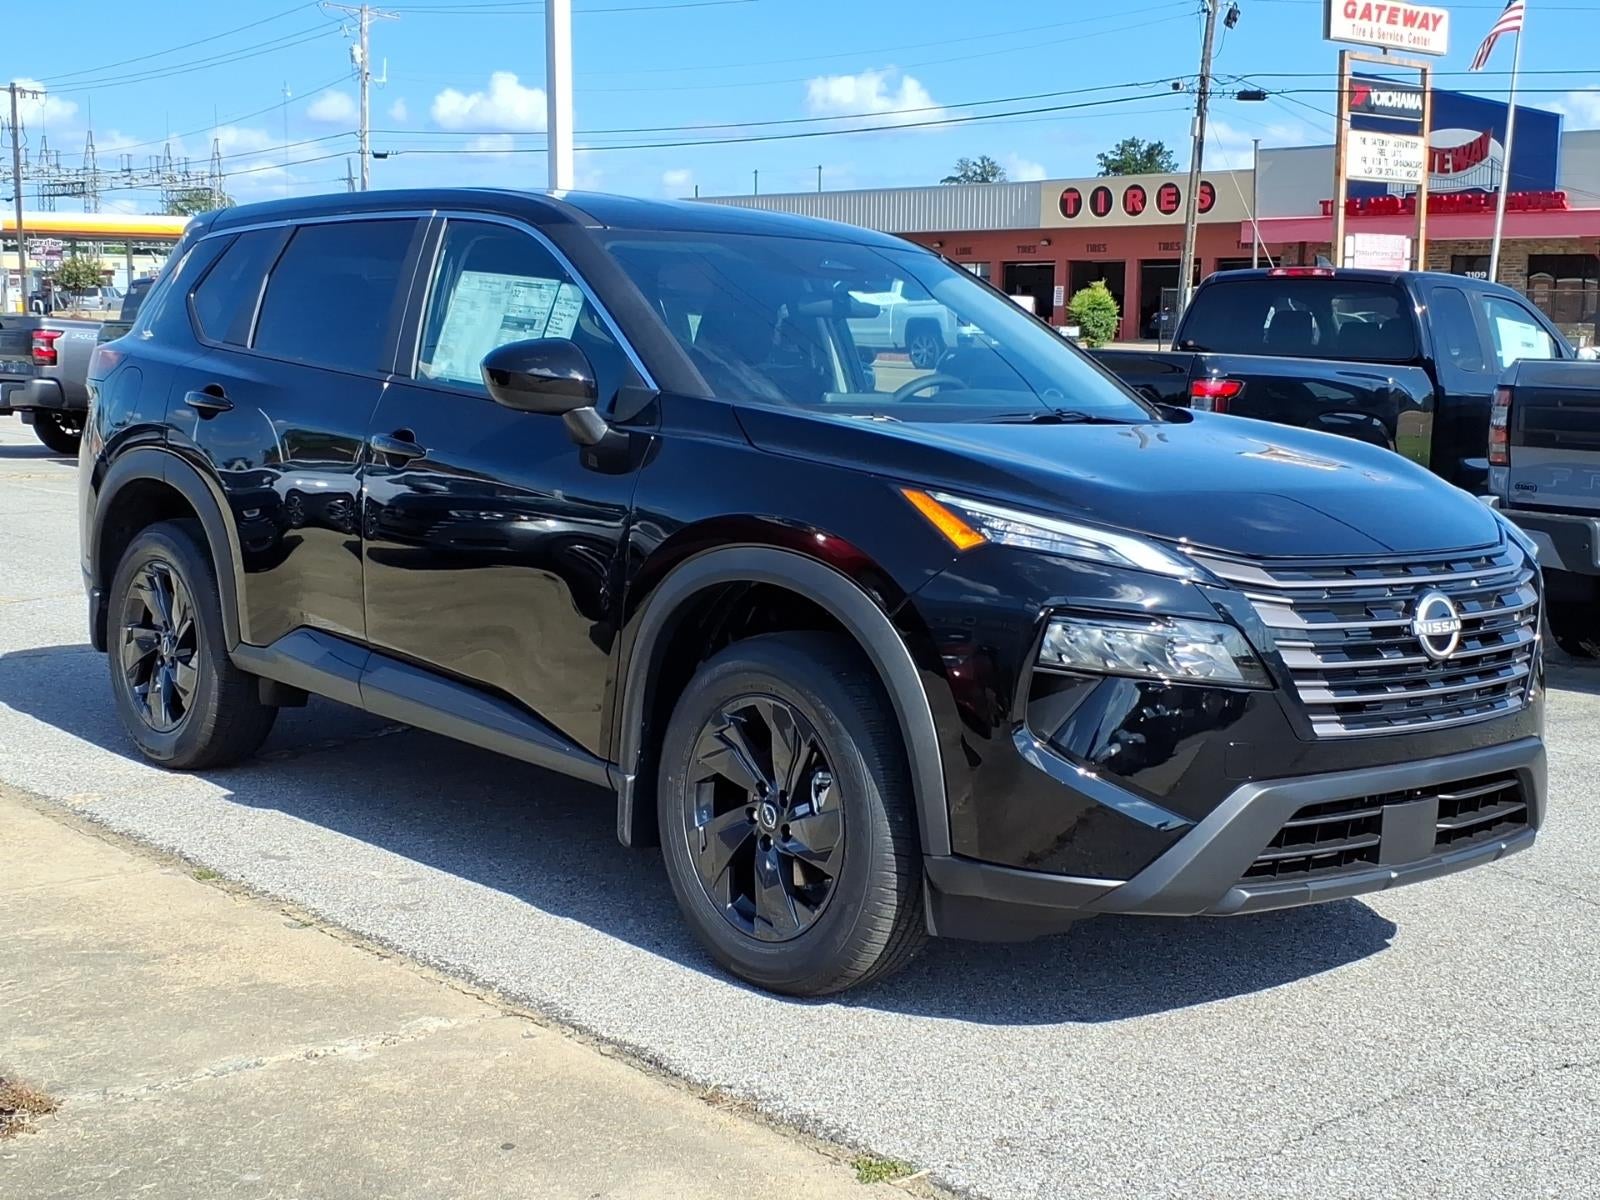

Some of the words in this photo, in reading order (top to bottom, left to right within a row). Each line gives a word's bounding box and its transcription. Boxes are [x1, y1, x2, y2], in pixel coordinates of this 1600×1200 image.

[1344, 0, 1443, 32] GATEWAY
[1352, 24, 1366, 37] Tire
[1377, 28, 1404, 43] Service
[1408, 32, 1431, 46] Center
[1370, 88, 1423, 110] YOKOHAMA
[1429, 128, 1492, 173] TEWAY
[1063, 186, 1211, 215] TIRES
[1016, 245, 1037, 254] TIRES
[1086, 243, 1107, 253] TIRES
[1465, 271, 1487, 279] 3109
[1414, 619, 1461, 635] NISSAN
